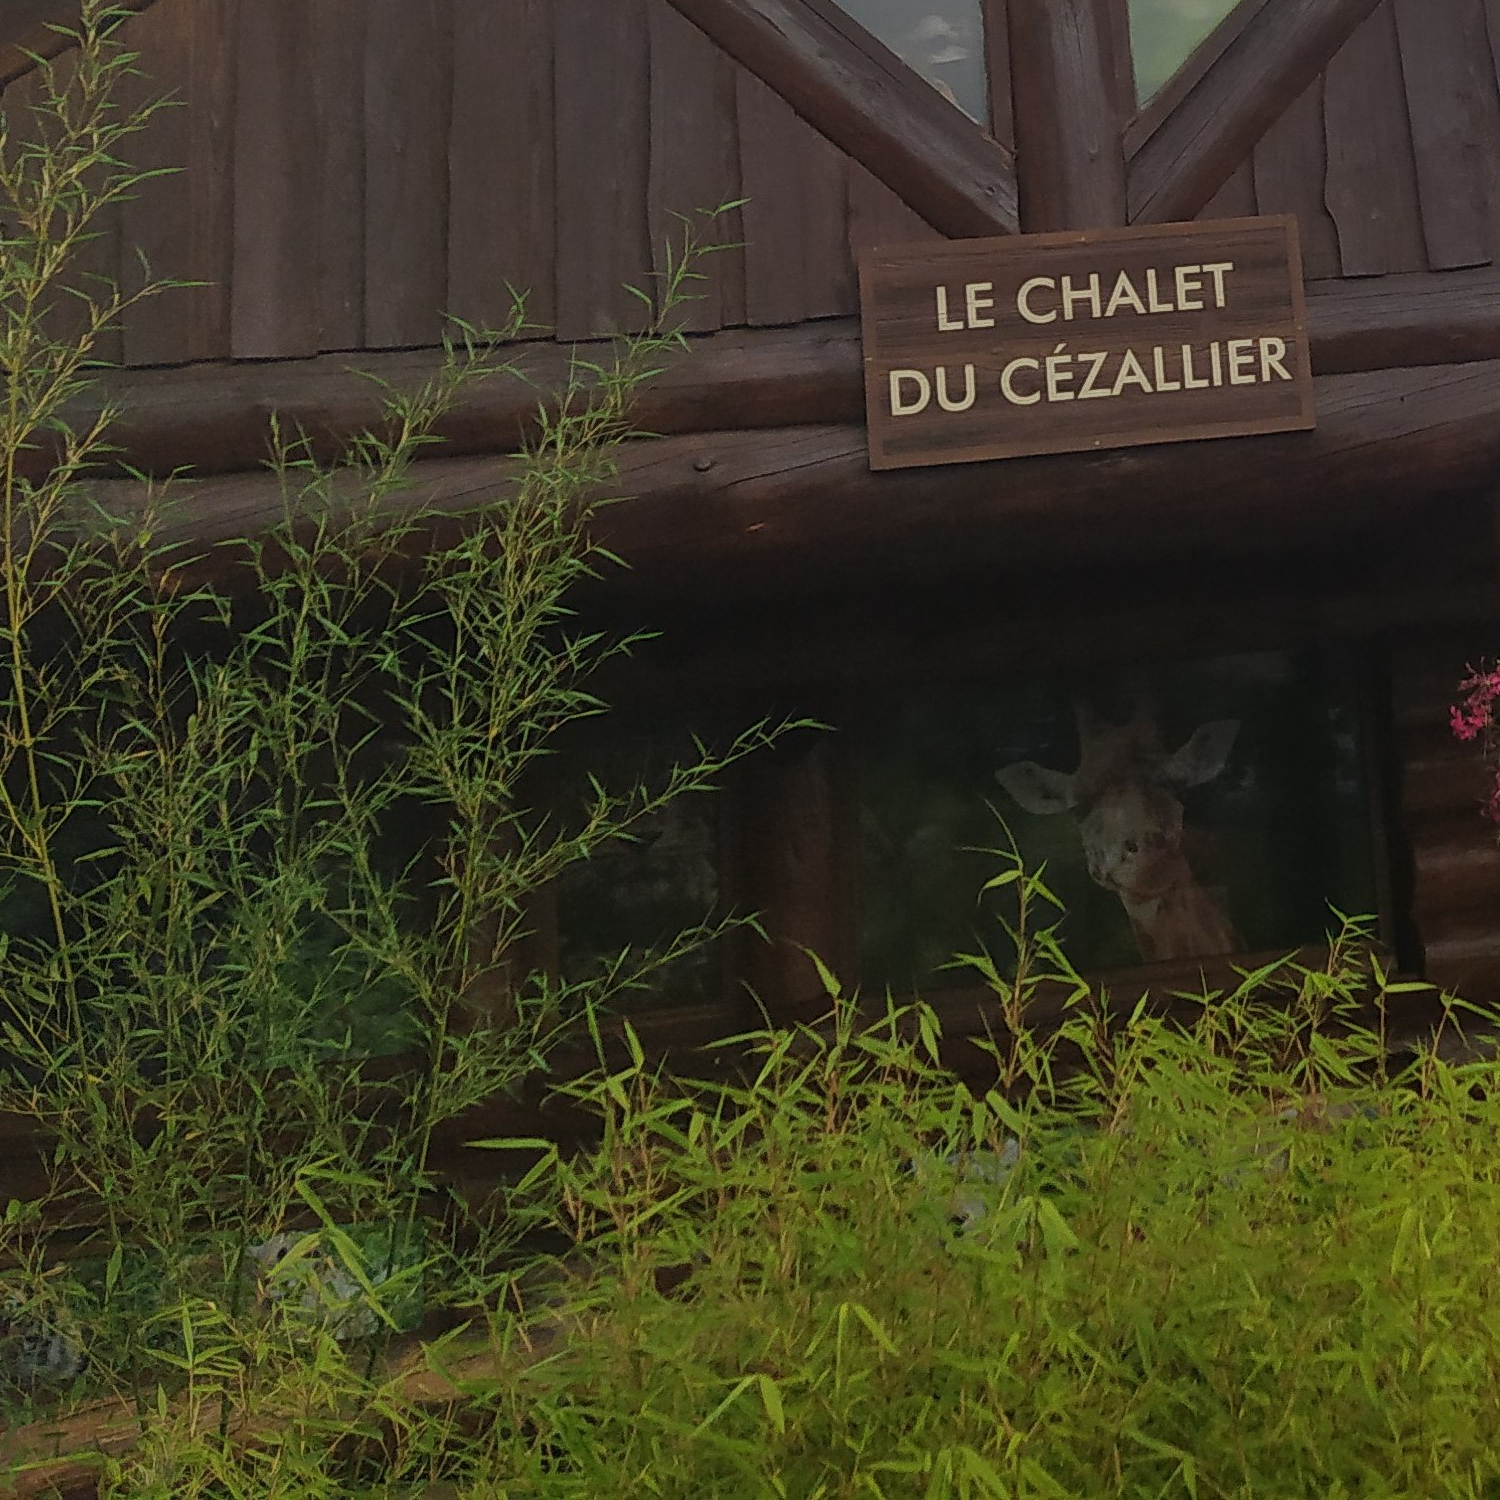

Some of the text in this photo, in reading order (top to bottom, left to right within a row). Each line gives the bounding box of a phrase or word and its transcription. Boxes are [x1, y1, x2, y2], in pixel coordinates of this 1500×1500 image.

[937, 262, 1234, 332] LE CHALET
[889, 337, 1293, 416] DU CÉZALLIER
